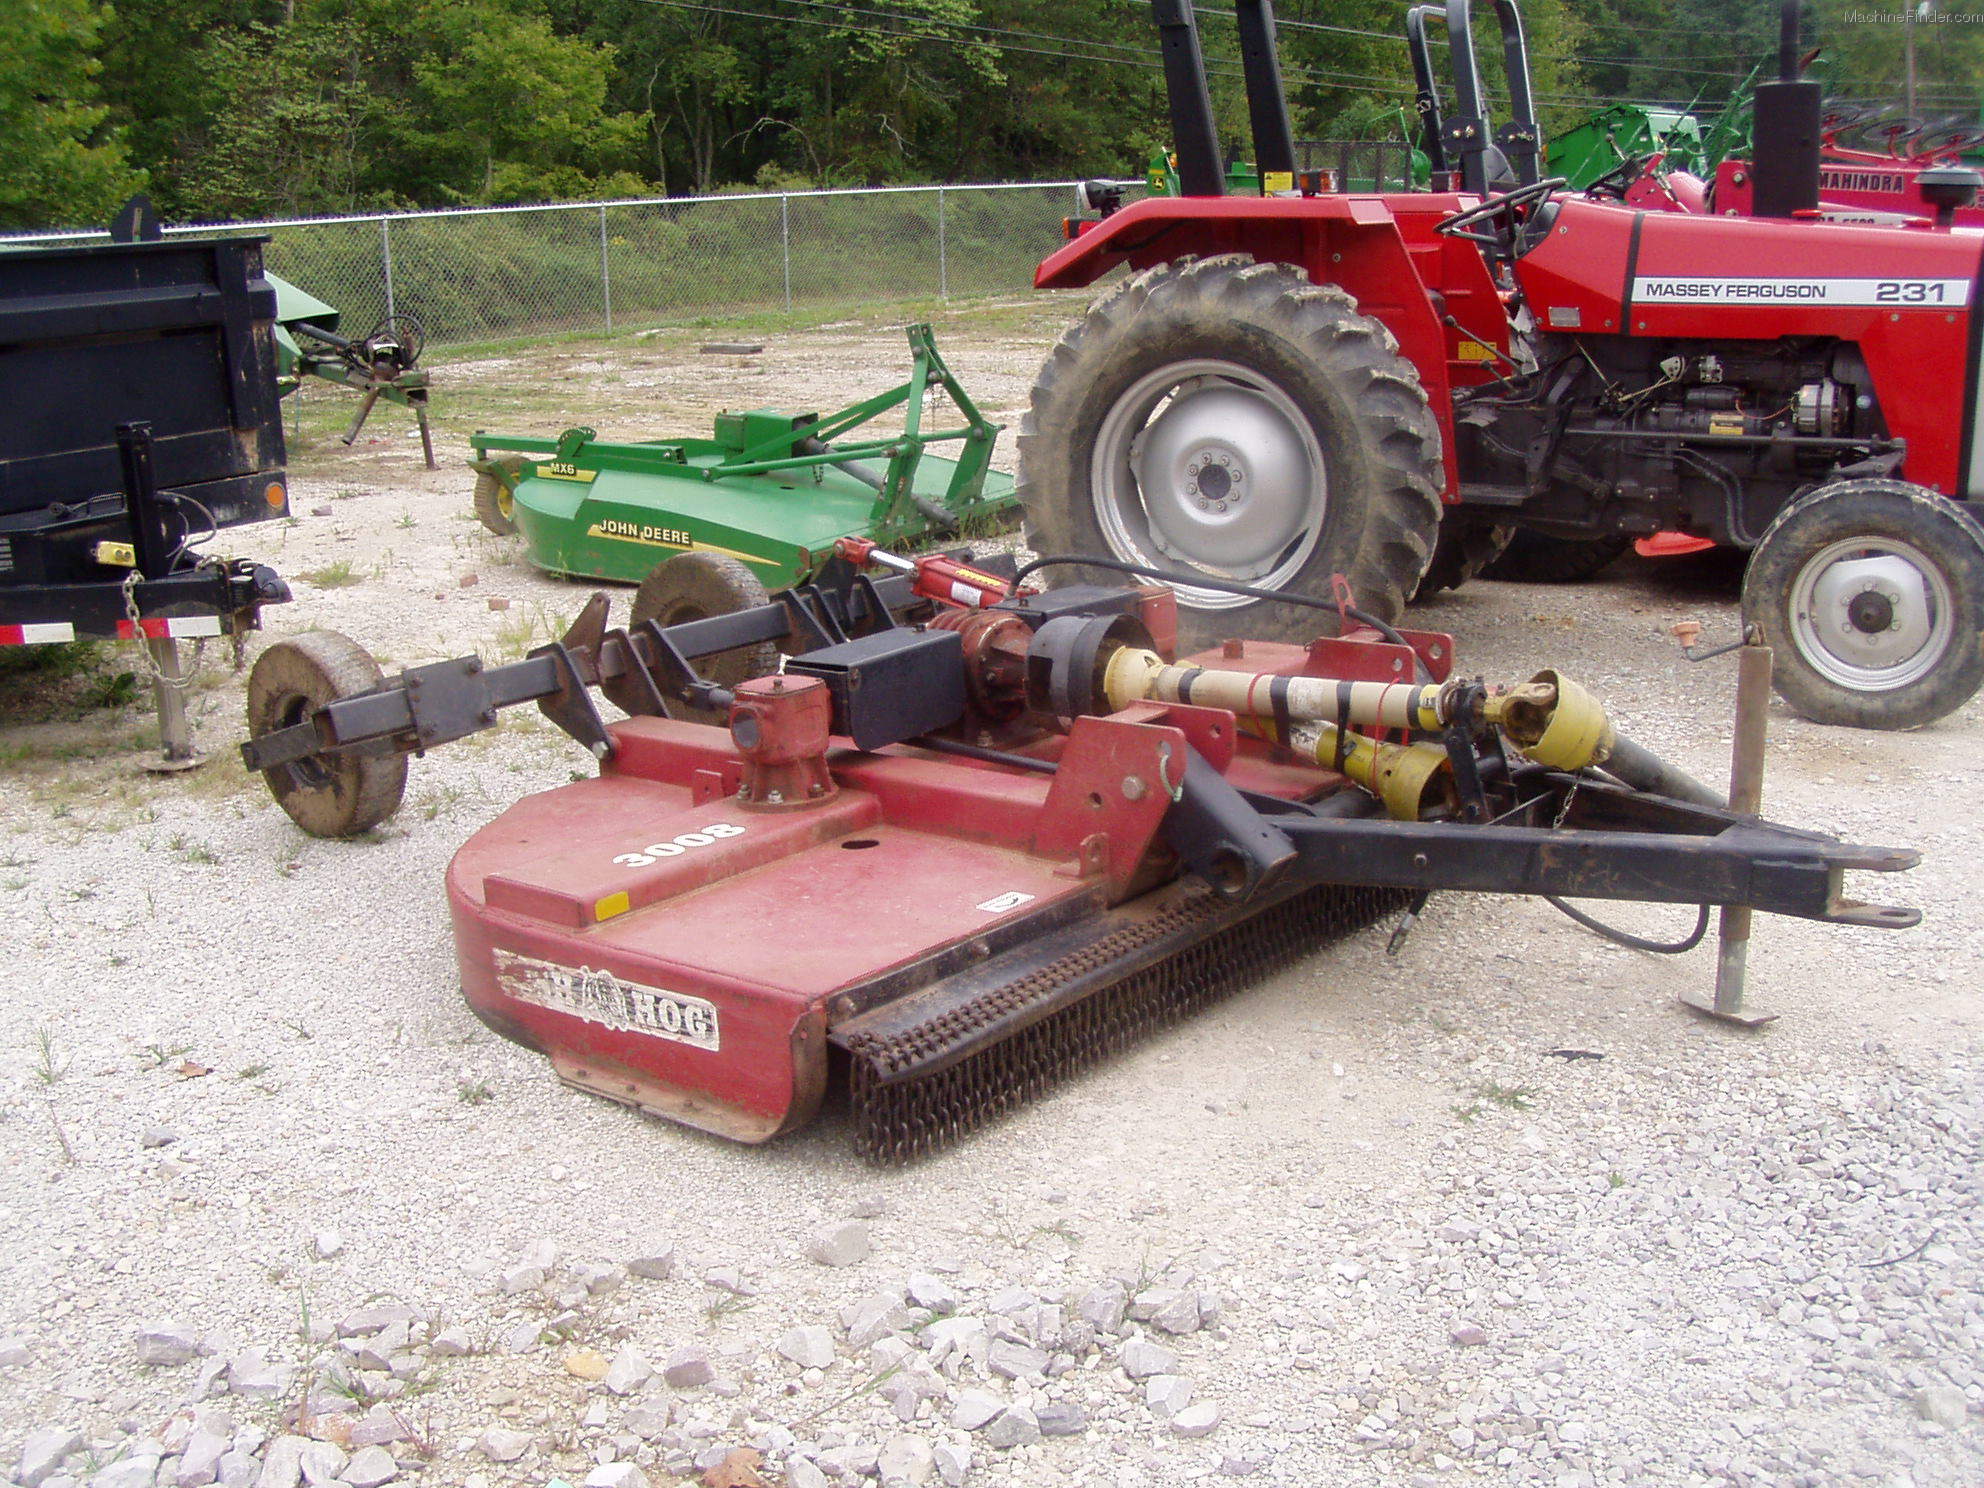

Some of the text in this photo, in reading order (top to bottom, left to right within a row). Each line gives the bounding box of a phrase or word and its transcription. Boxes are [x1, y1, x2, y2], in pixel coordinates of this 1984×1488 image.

[1646, 282, 1945, 302] MASSEY FERGUSON 231
[550, 463, 576, 476] MX6
[599, 519, 691, 545] JOHN DEERE
[612, 823, 747, 868] 3008
[630, 989, 708, 1039] HOG
